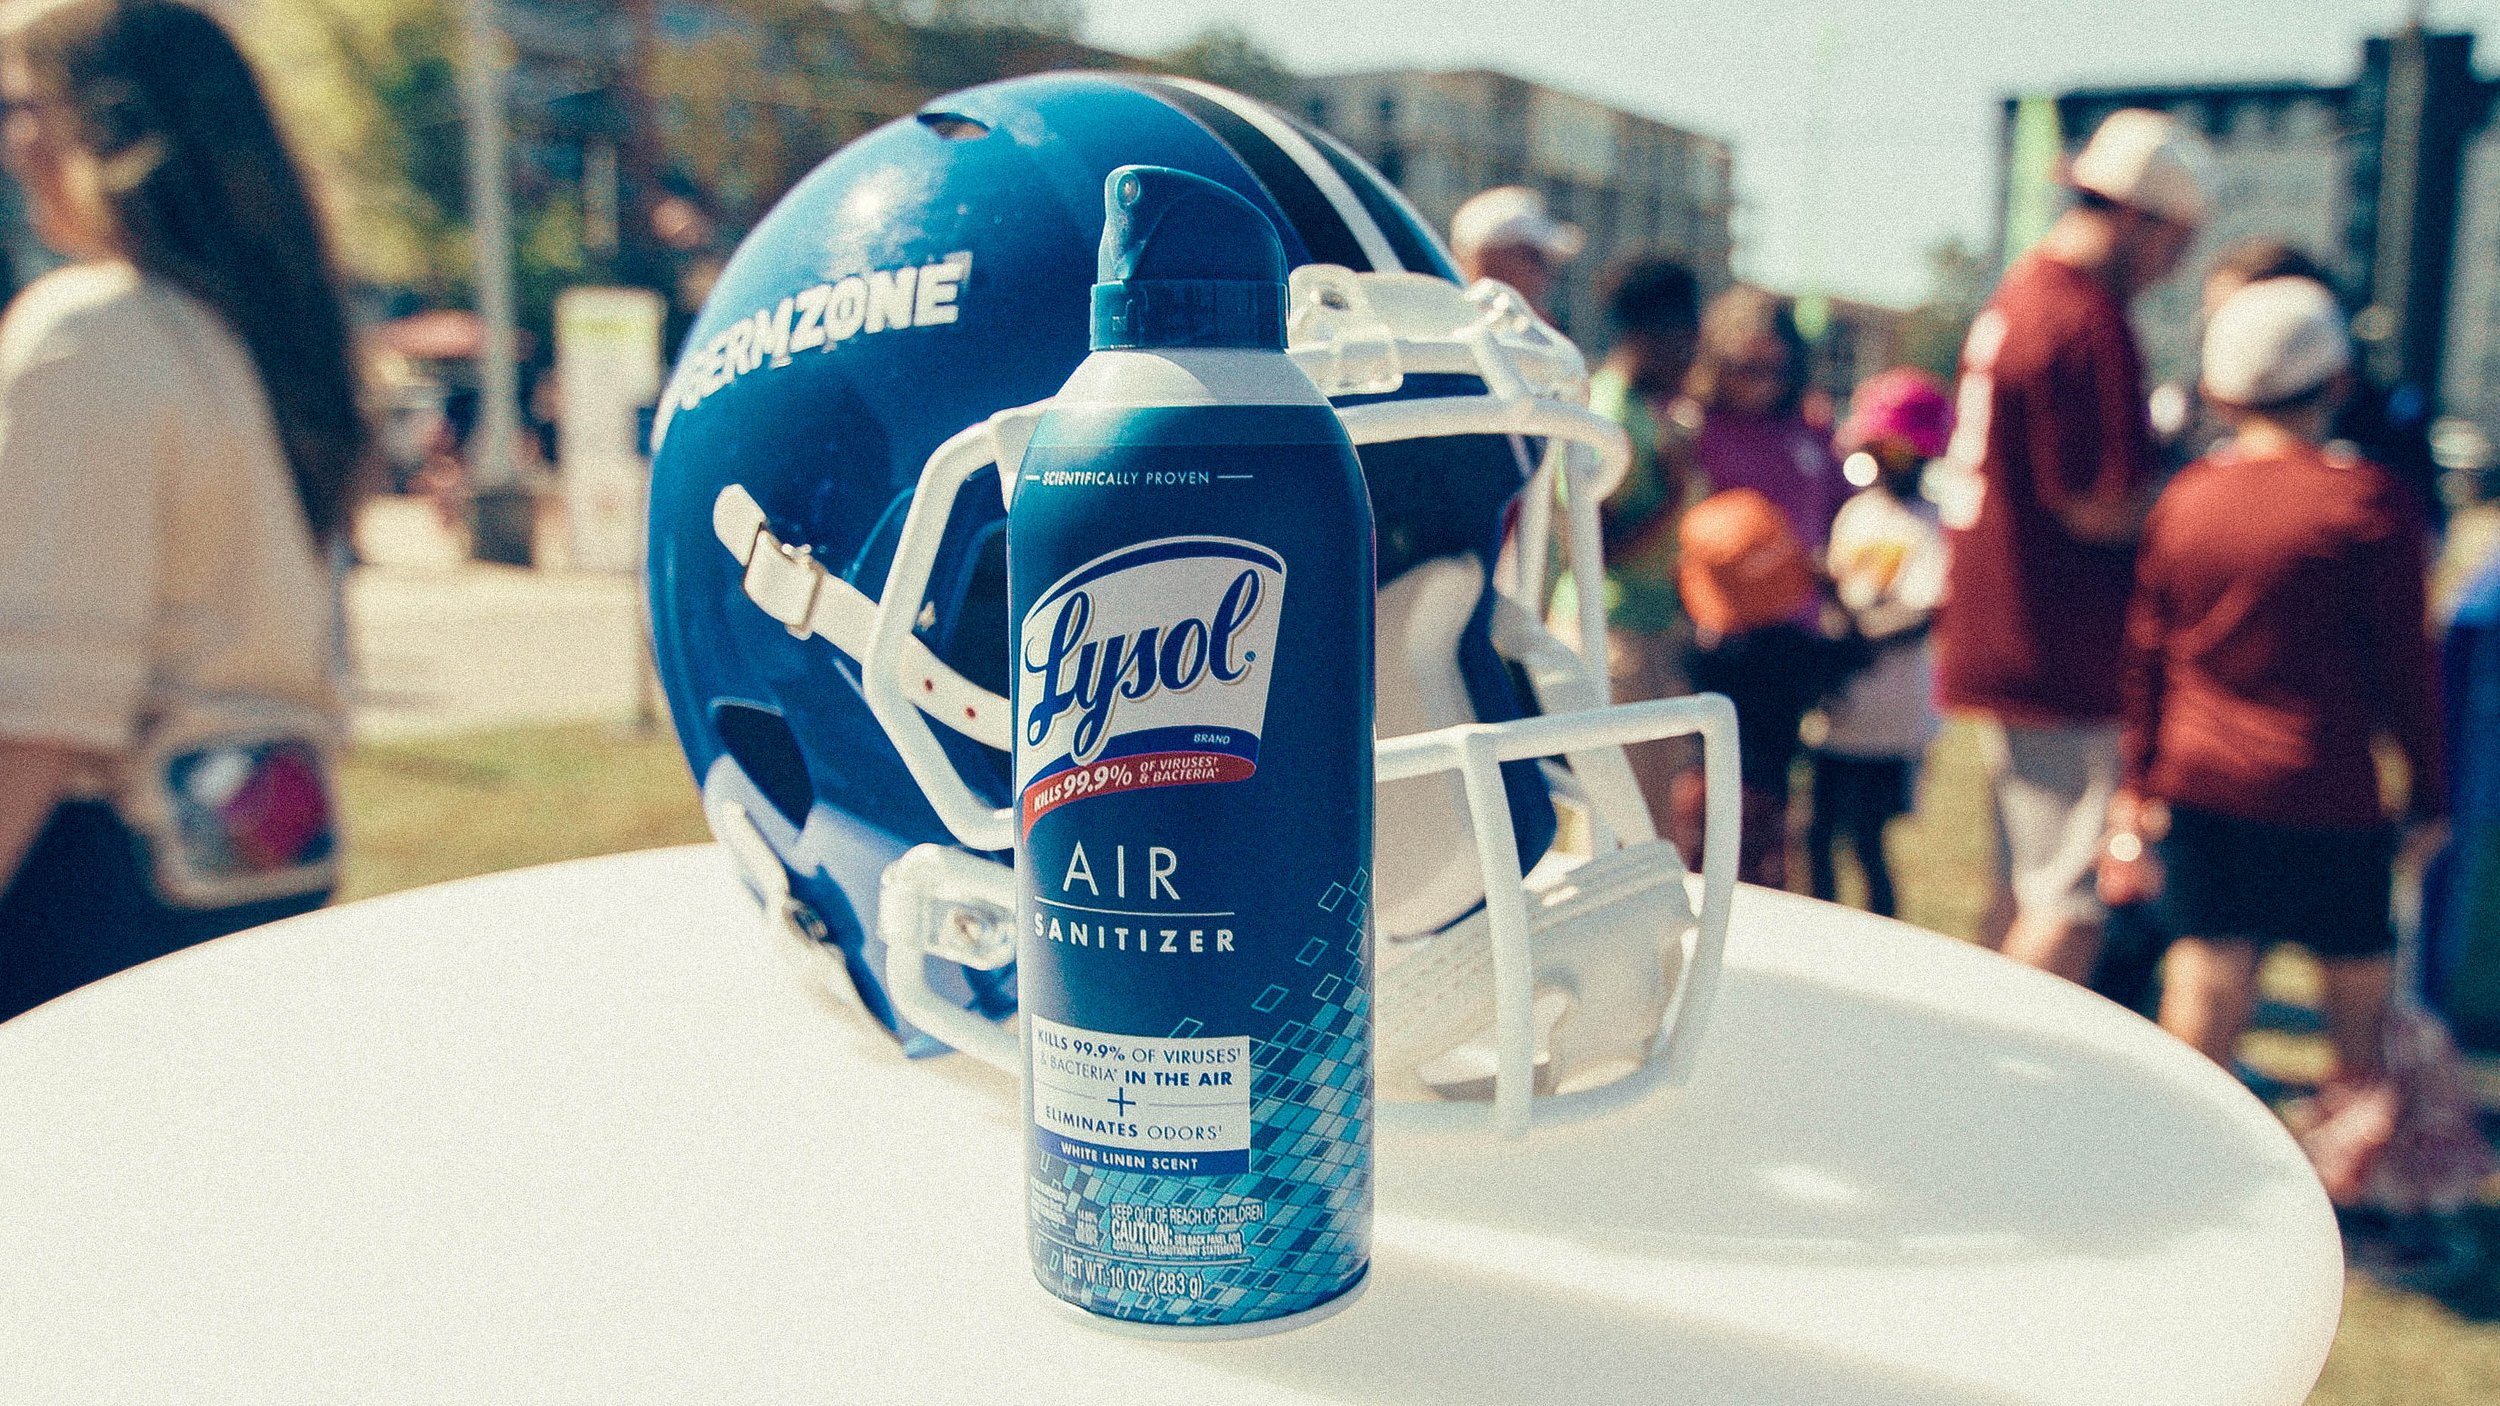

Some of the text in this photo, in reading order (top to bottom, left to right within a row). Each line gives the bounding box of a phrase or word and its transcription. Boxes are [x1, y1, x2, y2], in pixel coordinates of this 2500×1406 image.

[1041, 471, 1210, 486] SCIENTIFICALLY PROVEN
[1193, 733, 1231, 745] BRAND
[1140, 761, 1156, 772] OF
[1140, 772, 1149, 784] &
[1033, 763, 1132, 813] KILLS 99.9%
[1062, 839, 1181, 901] AIR
[1034, 912, 1235, 953] SANITIZER
[1037, 1030, 1068, 1051] KILLS
[1073, 1039, 1126, 1062] 99.9%
[1132, 1048, 1156, 1064] OF
[1125, 1070, 1146, 1085] IN
[1154, 1071, 1190, 1087] THE
[1198, 1071, 1233, 1087] AIR
[1046, 1105, 1138, 1138] ELIMINATES
[1060, 1141, 1199, 1171] WHITE LINEN SCENT
[1111, 1202, 1264, 1226] KEEP OUT OF REACH OF CHILDREN
[1111, 1217, 1173, 1246] CAUTION:
[1062, 1251, 1084, 1279] NET
[1110, 1267, 1125, 1289] 10
[1127, 1269, 1151, 1293] OZ.
[1154, 1272, 1186, 1297] (283
[1189, 1273, 1203, 1300] g)
